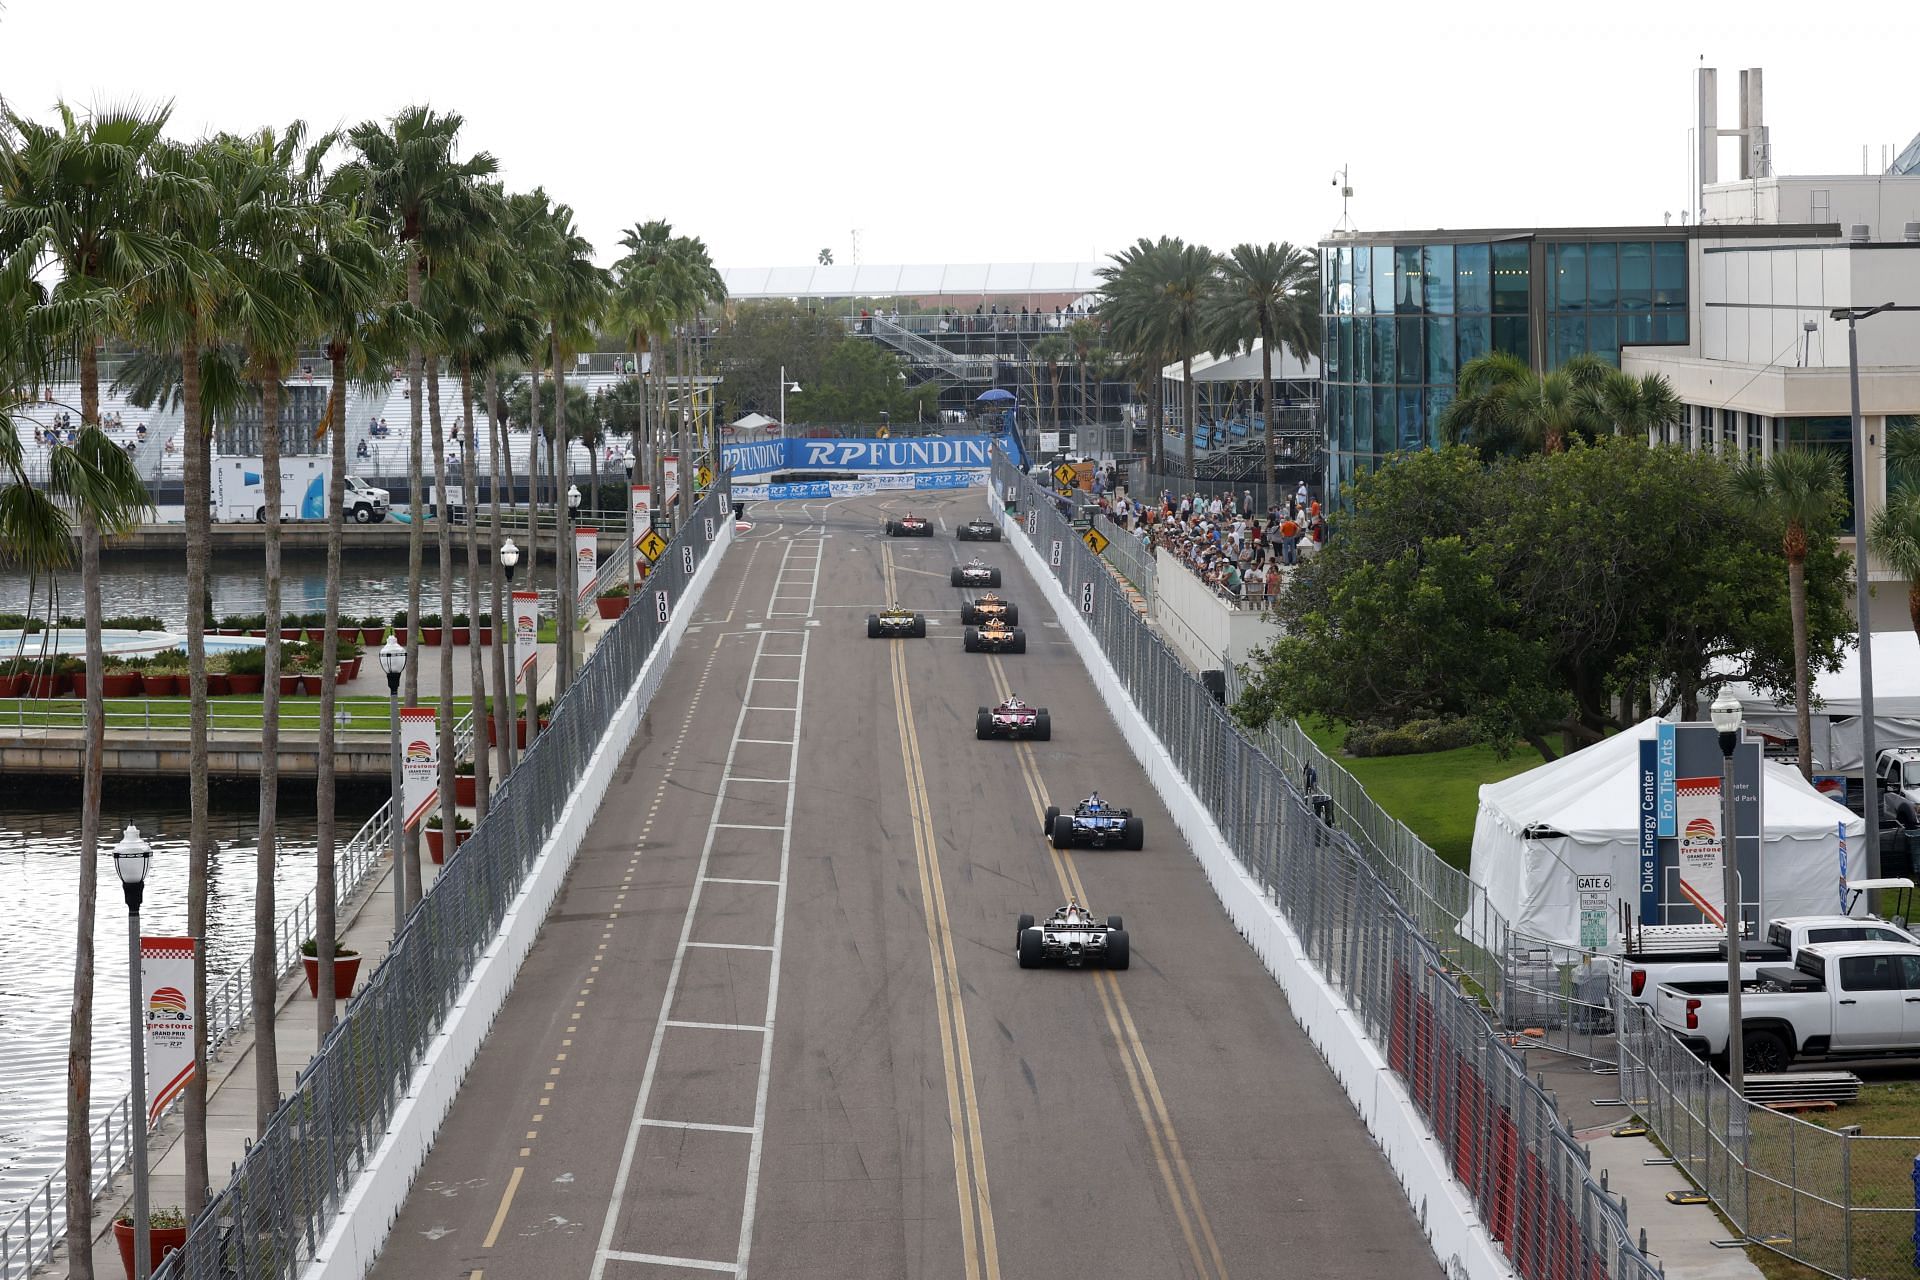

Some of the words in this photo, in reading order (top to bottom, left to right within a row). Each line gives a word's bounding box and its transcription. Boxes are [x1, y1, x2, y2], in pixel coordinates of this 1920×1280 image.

[740, 443, 785, 471] FUNDING
[805, 442, 867, 465] RP
[936, 474, 951, 482] RP
[720, 495, 728, 513] 100
[658, 592, 667, 621] 400
[1661, 739, 1673, 764] Arts
[1643, 770, 1654, 811] Center
[1661, 770, 1673, 795] The
[1661, 803, 1673, 819] For
[1642, 817, 1656, 856] Energy
[1579, 879, 1601, 888] GATE
[1603, 879, 1610, 888] 6
[1642, 862, 1653, 893] Duke
[147, 1023, 194, 1031] Firestone
